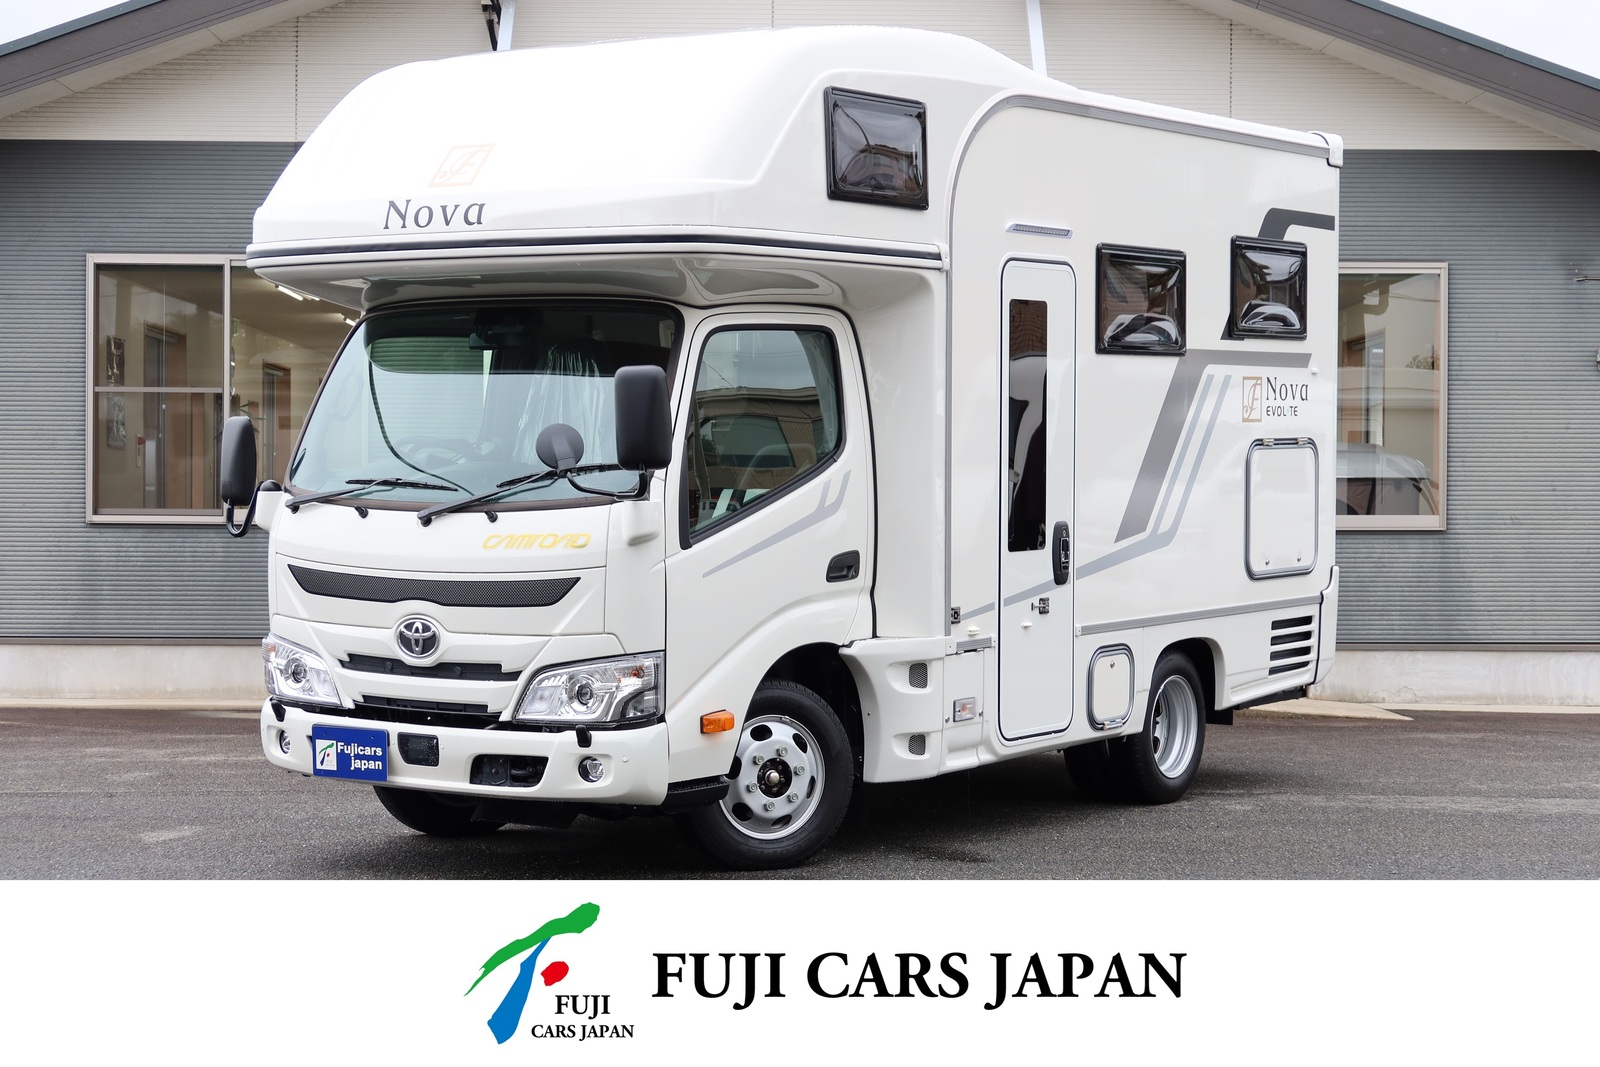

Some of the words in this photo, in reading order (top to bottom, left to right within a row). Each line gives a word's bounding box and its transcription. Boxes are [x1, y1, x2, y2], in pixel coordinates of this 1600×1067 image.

[383, 199, 486, 230] Nova
[1266, 376, 1309, 402] Nova
[337, 742, 383, 757] Fujicars
[350, 757, 383, 771] japan
